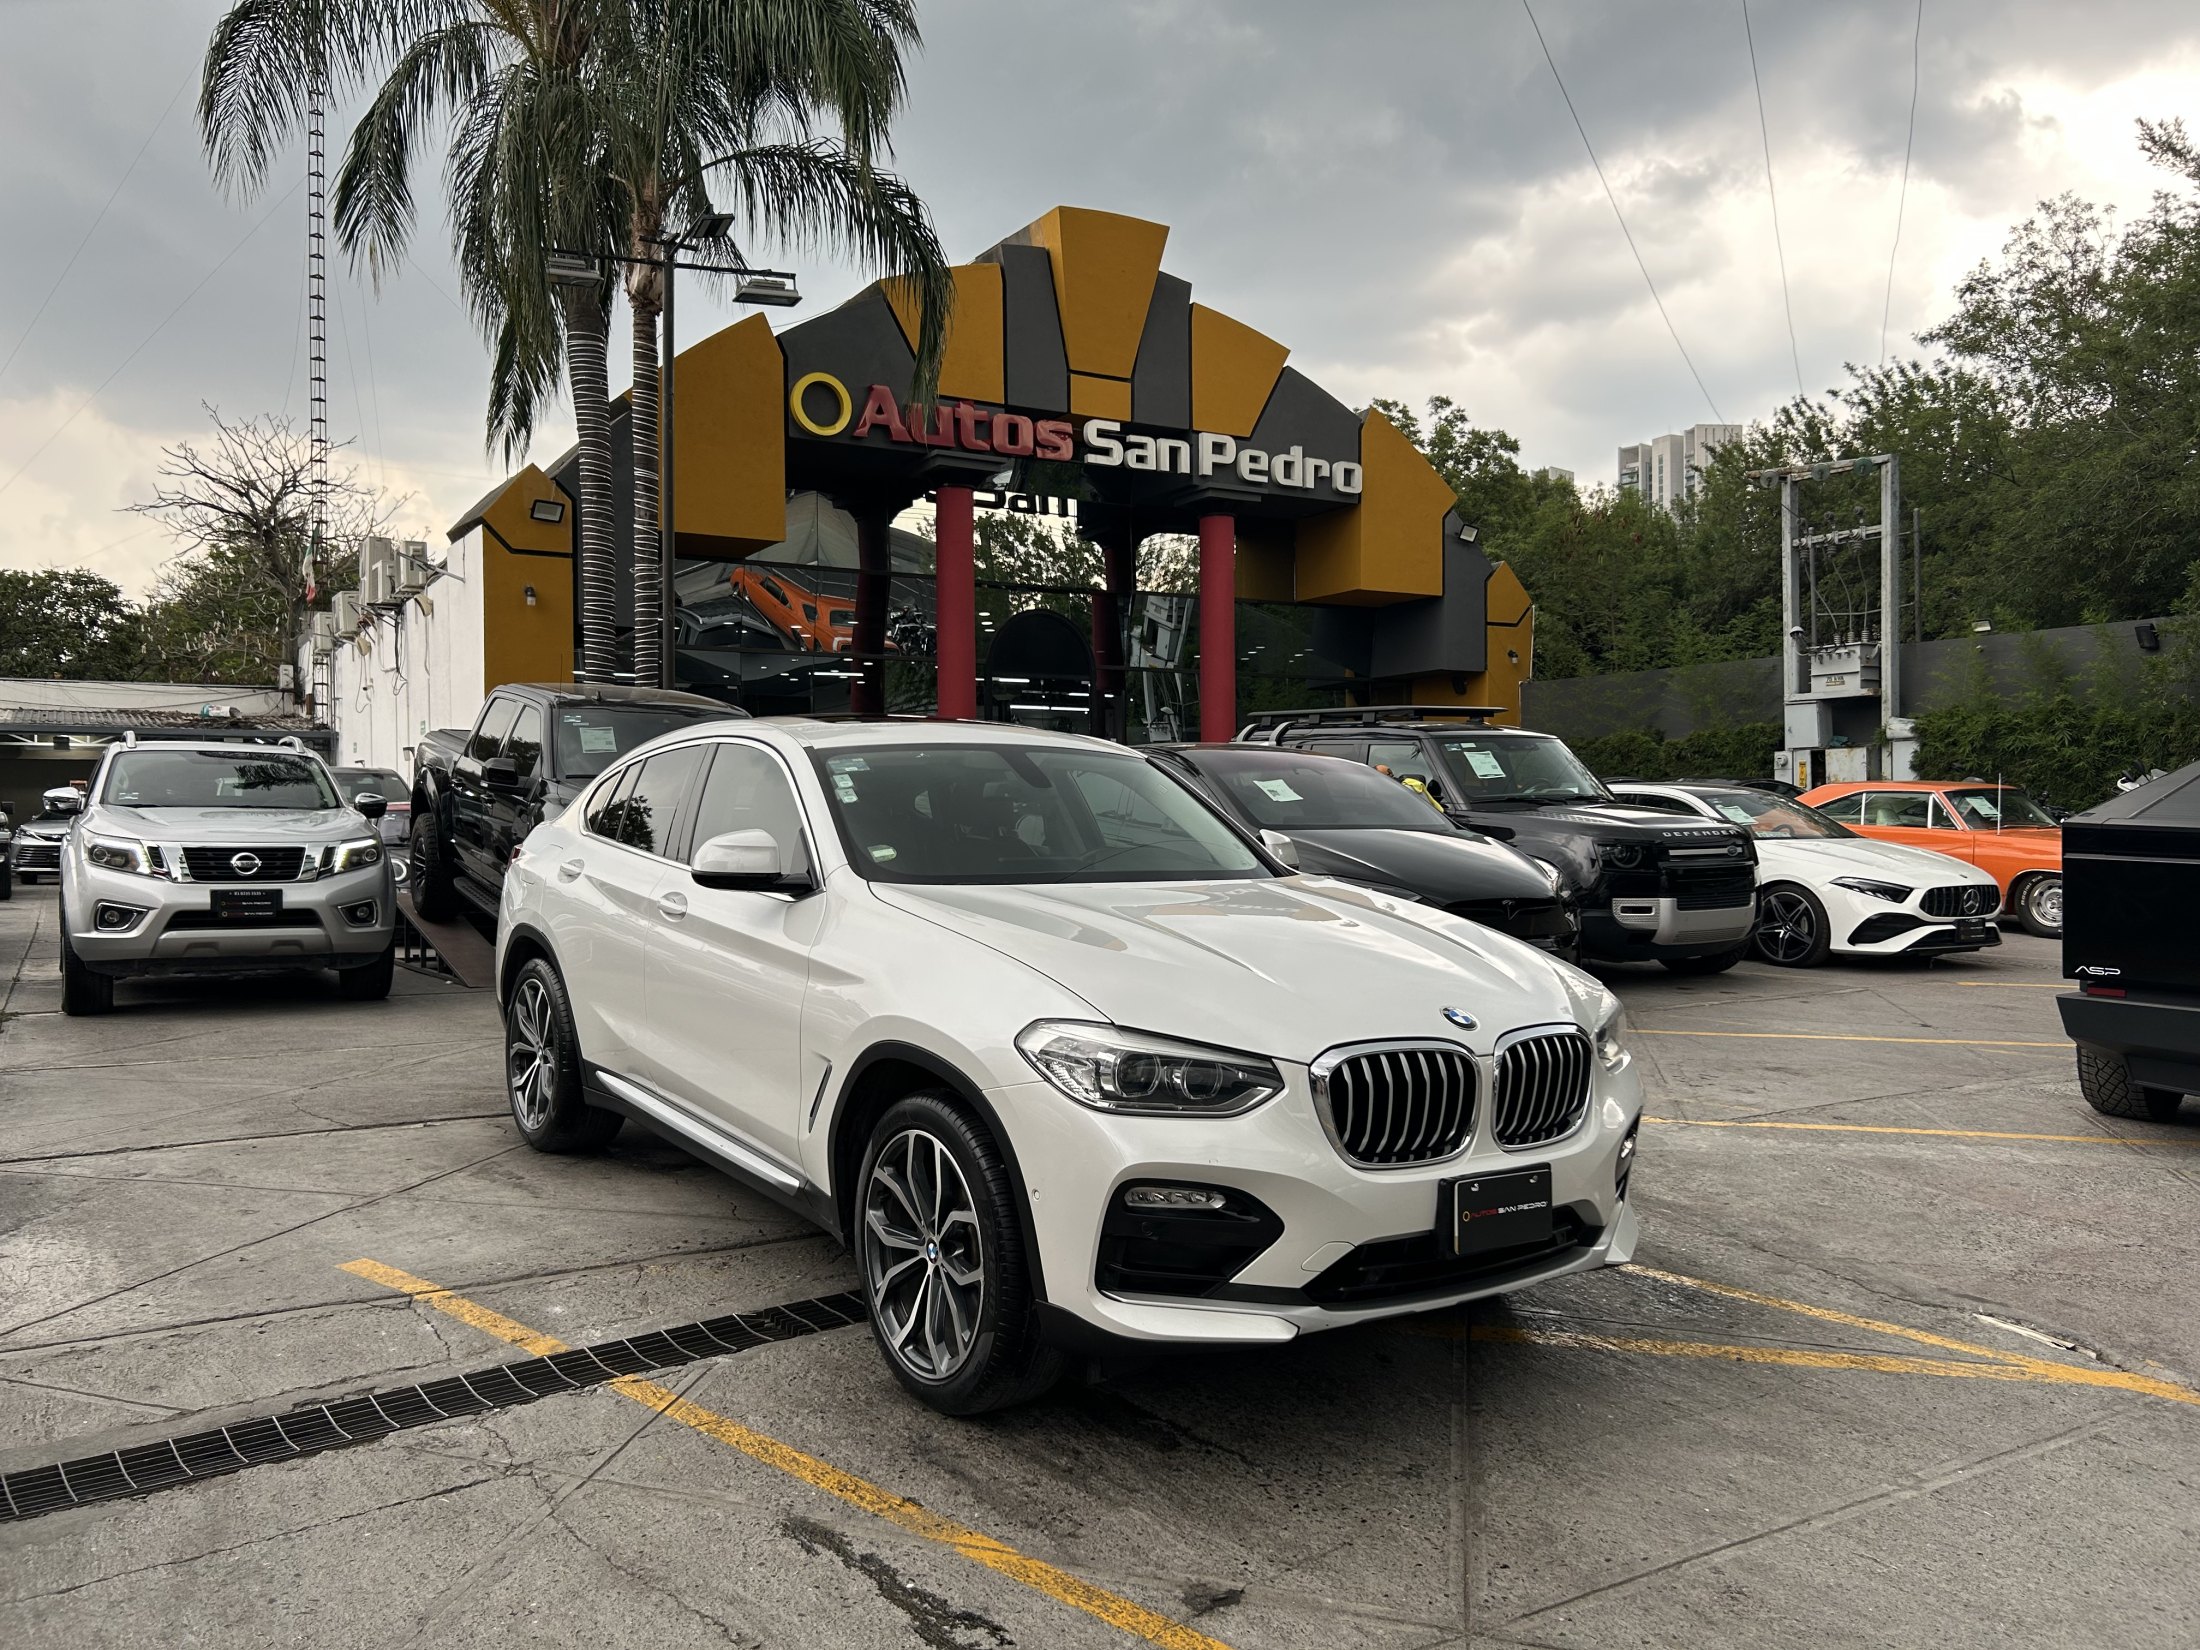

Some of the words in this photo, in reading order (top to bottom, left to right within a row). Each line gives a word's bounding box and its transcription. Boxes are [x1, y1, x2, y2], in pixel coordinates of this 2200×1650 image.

[853, 384, 1074, 462] Autos
[1083, 418, 1191, 475] San
[1199, 431, 1363, 495] Pedro
[1662, 829, 1737, 838] DEFENDER
[2074, 965, 2121, 976] ASP
[1498, 1206, 1516, 1214] SAN
